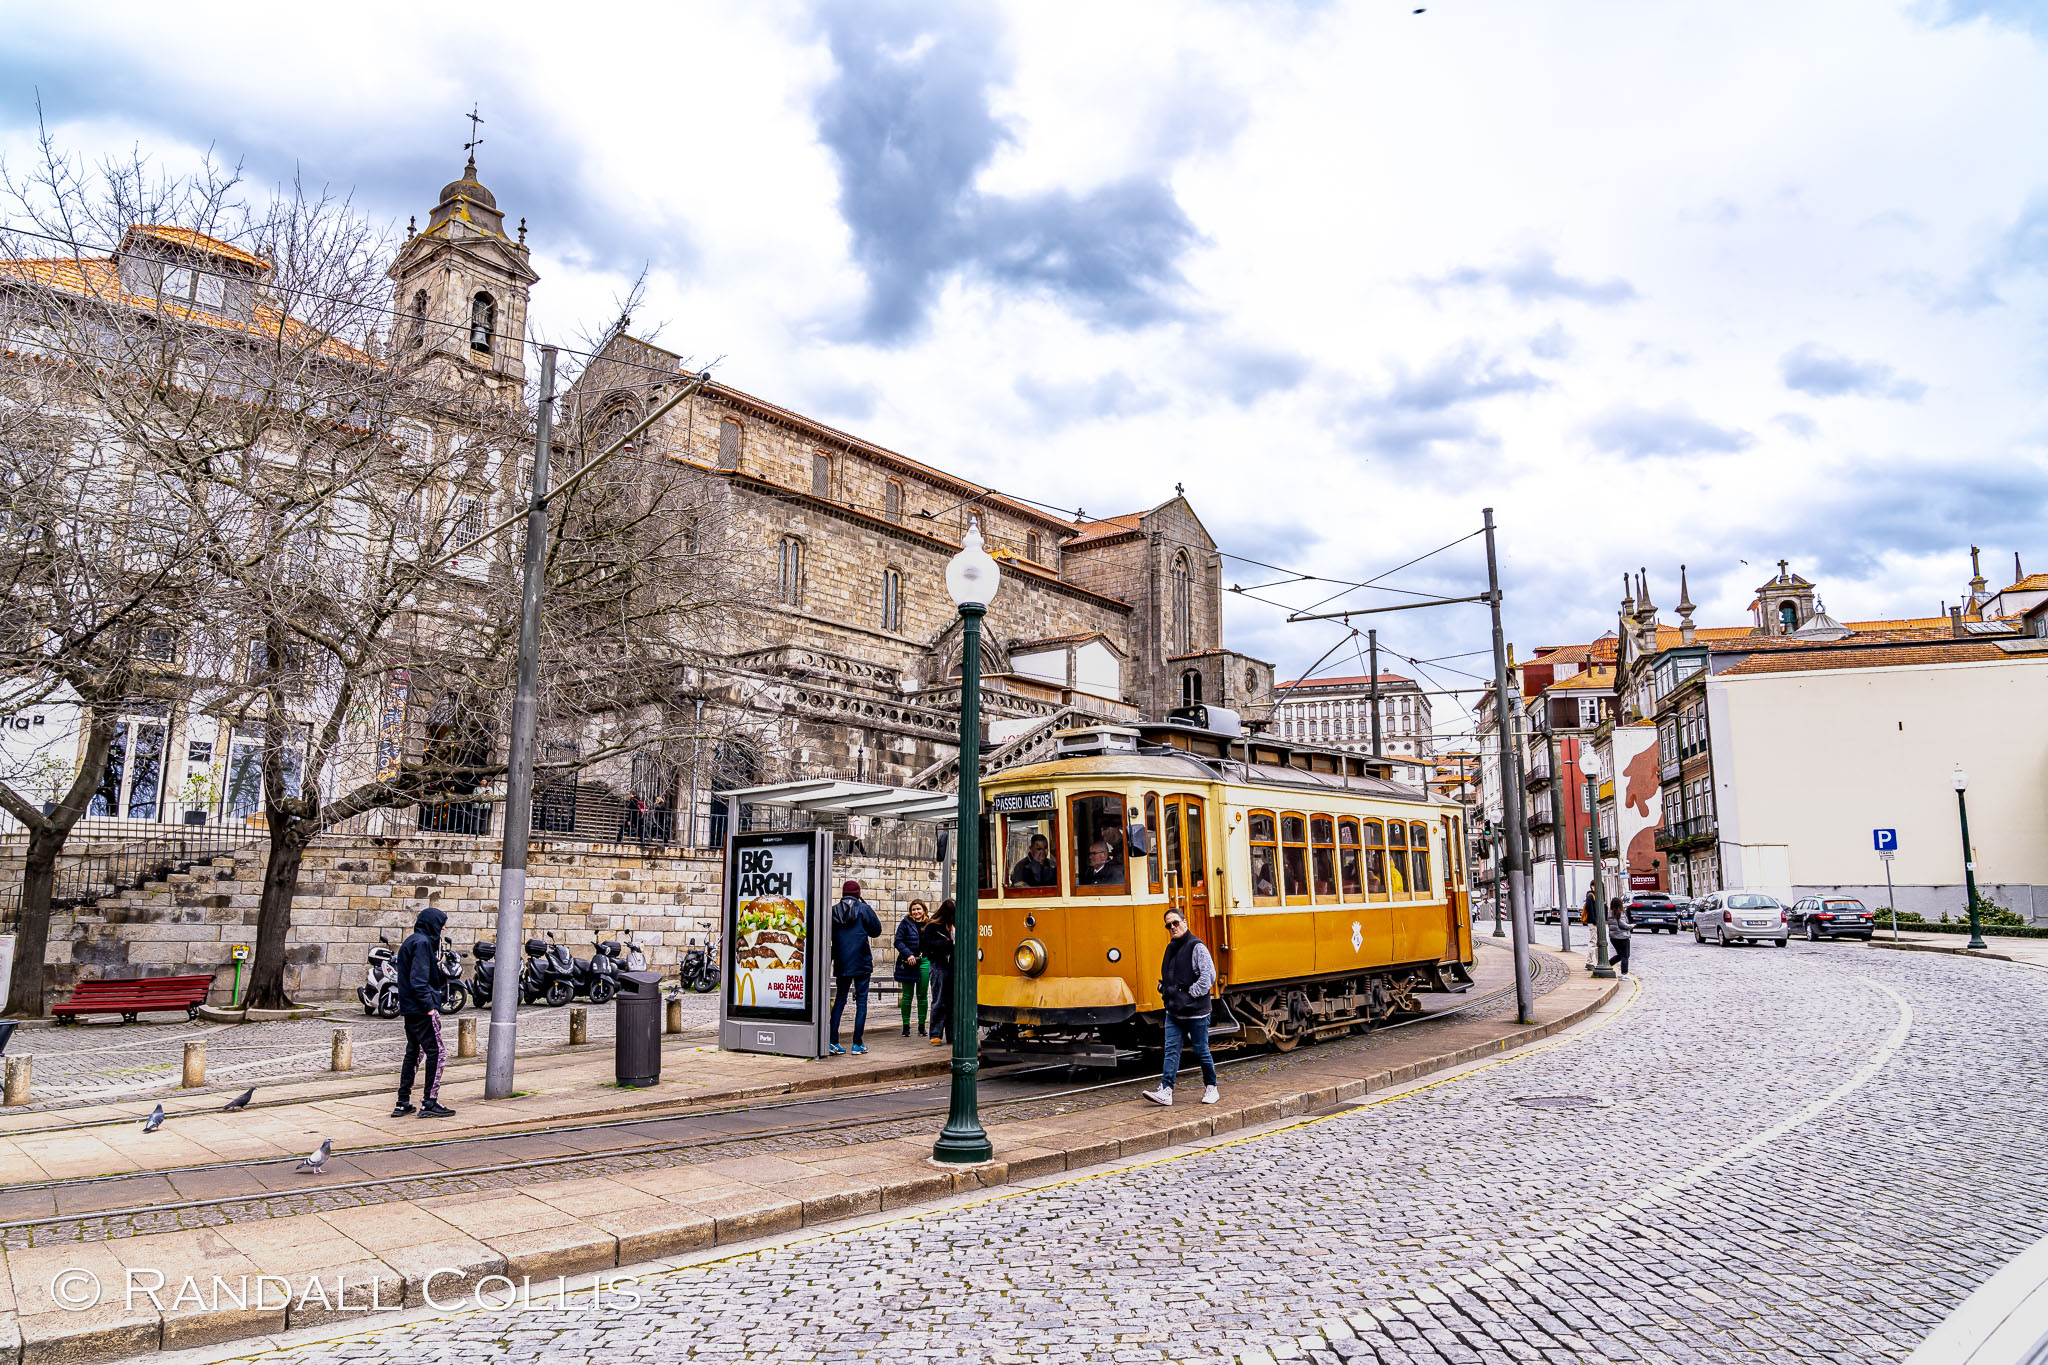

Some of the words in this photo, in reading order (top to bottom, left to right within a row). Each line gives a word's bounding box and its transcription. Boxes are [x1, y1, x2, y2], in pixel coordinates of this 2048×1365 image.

[995, 796, 1023, 811] PASSEIO
[1024, 794, 1050, 809] ALEGRE
[1878, 830, 1892, 849] P
[741, 849, 773, 874] BIG
[738, 872, 793, 896] ARCH
[979, 925, 992, 936] 205
[786, 975, 804, 984] PARA
[767, 982, 773, 991] A
[773, 982, 785, 991] BIG
[785, 983, 804, 992] FOME
[779, 991, 788, 999] DE
[788, 992, 804, 1000] MAC
